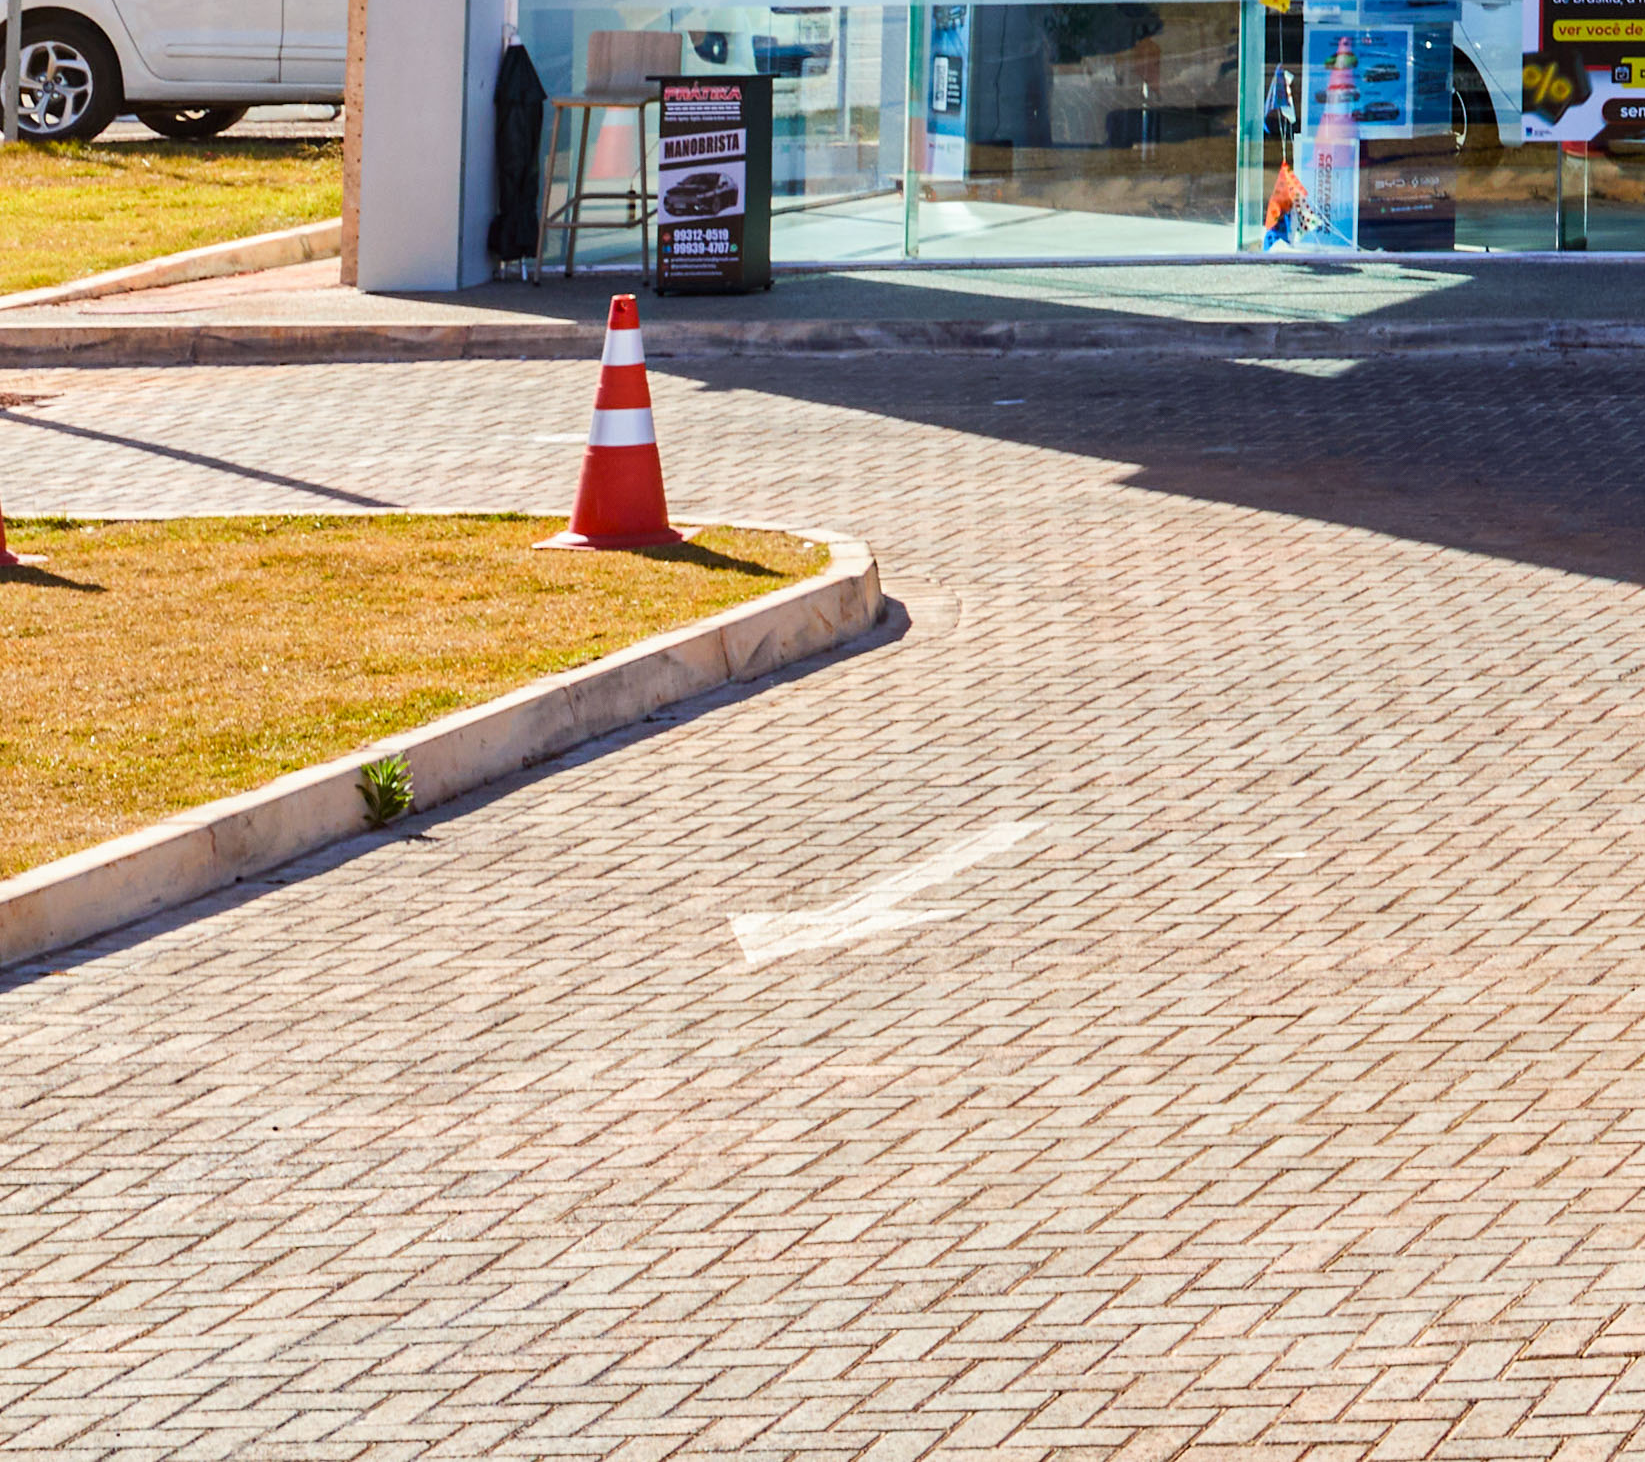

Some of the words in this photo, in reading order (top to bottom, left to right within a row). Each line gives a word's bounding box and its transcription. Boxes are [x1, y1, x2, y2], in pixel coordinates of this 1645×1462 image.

[1559, 26, 1582, 35] ver
[1586, 22, 1621, 35] você
[1625, 23, 1643, 35] de
[663, 80, 742, 101] PRÁTIKA
[664, 133, 740, 159] MANOBRISTA
[673, 228, 729, 242] 99312-0519
[673, 242, 729, 254] 99939-4707
